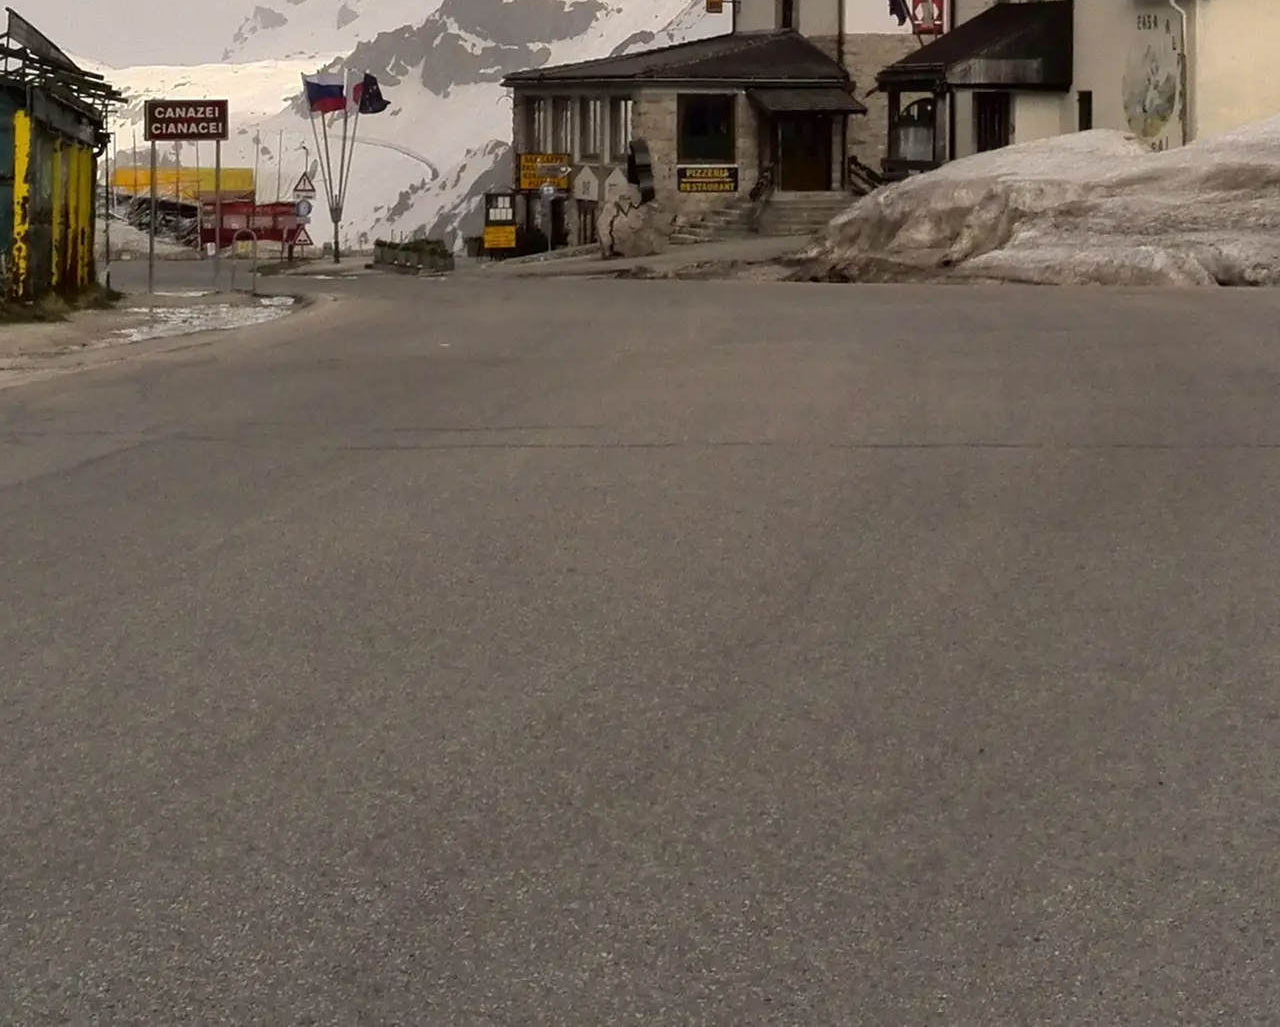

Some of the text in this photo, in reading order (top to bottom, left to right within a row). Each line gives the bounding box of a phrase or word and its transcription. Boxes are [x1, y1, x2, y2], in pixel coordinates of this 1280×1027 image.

[154, 106, 219, 118] CANAZEI
[151, 121, 223, 134] CIANACEI
[686, 168, 729, 177] PIZZERIA
